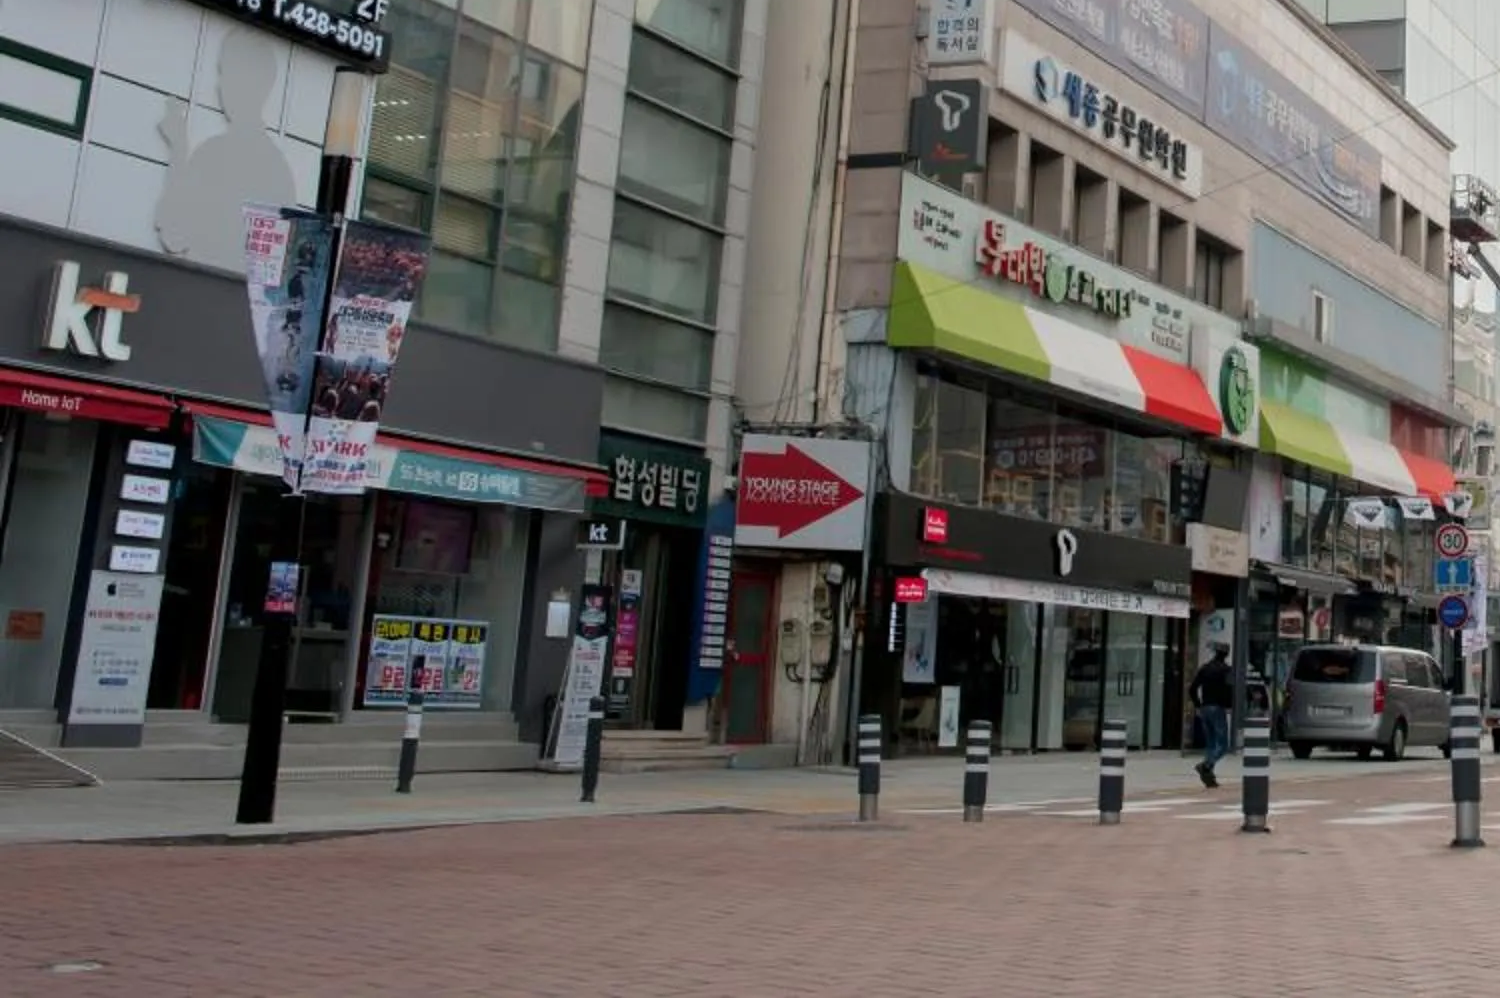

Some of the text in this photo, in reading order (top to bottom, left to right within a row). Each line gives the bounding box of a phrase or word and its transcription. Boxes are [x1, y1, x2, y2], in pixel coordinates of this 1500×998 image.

[1062, 70, 1188, 180] 세종공무원학원
[48, 259, 141, 362] kt
[21, 389, 84, 412] Home IoT
[614, 454, 702, 513] 협성빌딩
[746, 476, 841, 497] YOUNG STAGE
[589, 523, 609, 543] kt
[1442, 533, 1464, 550] 30
